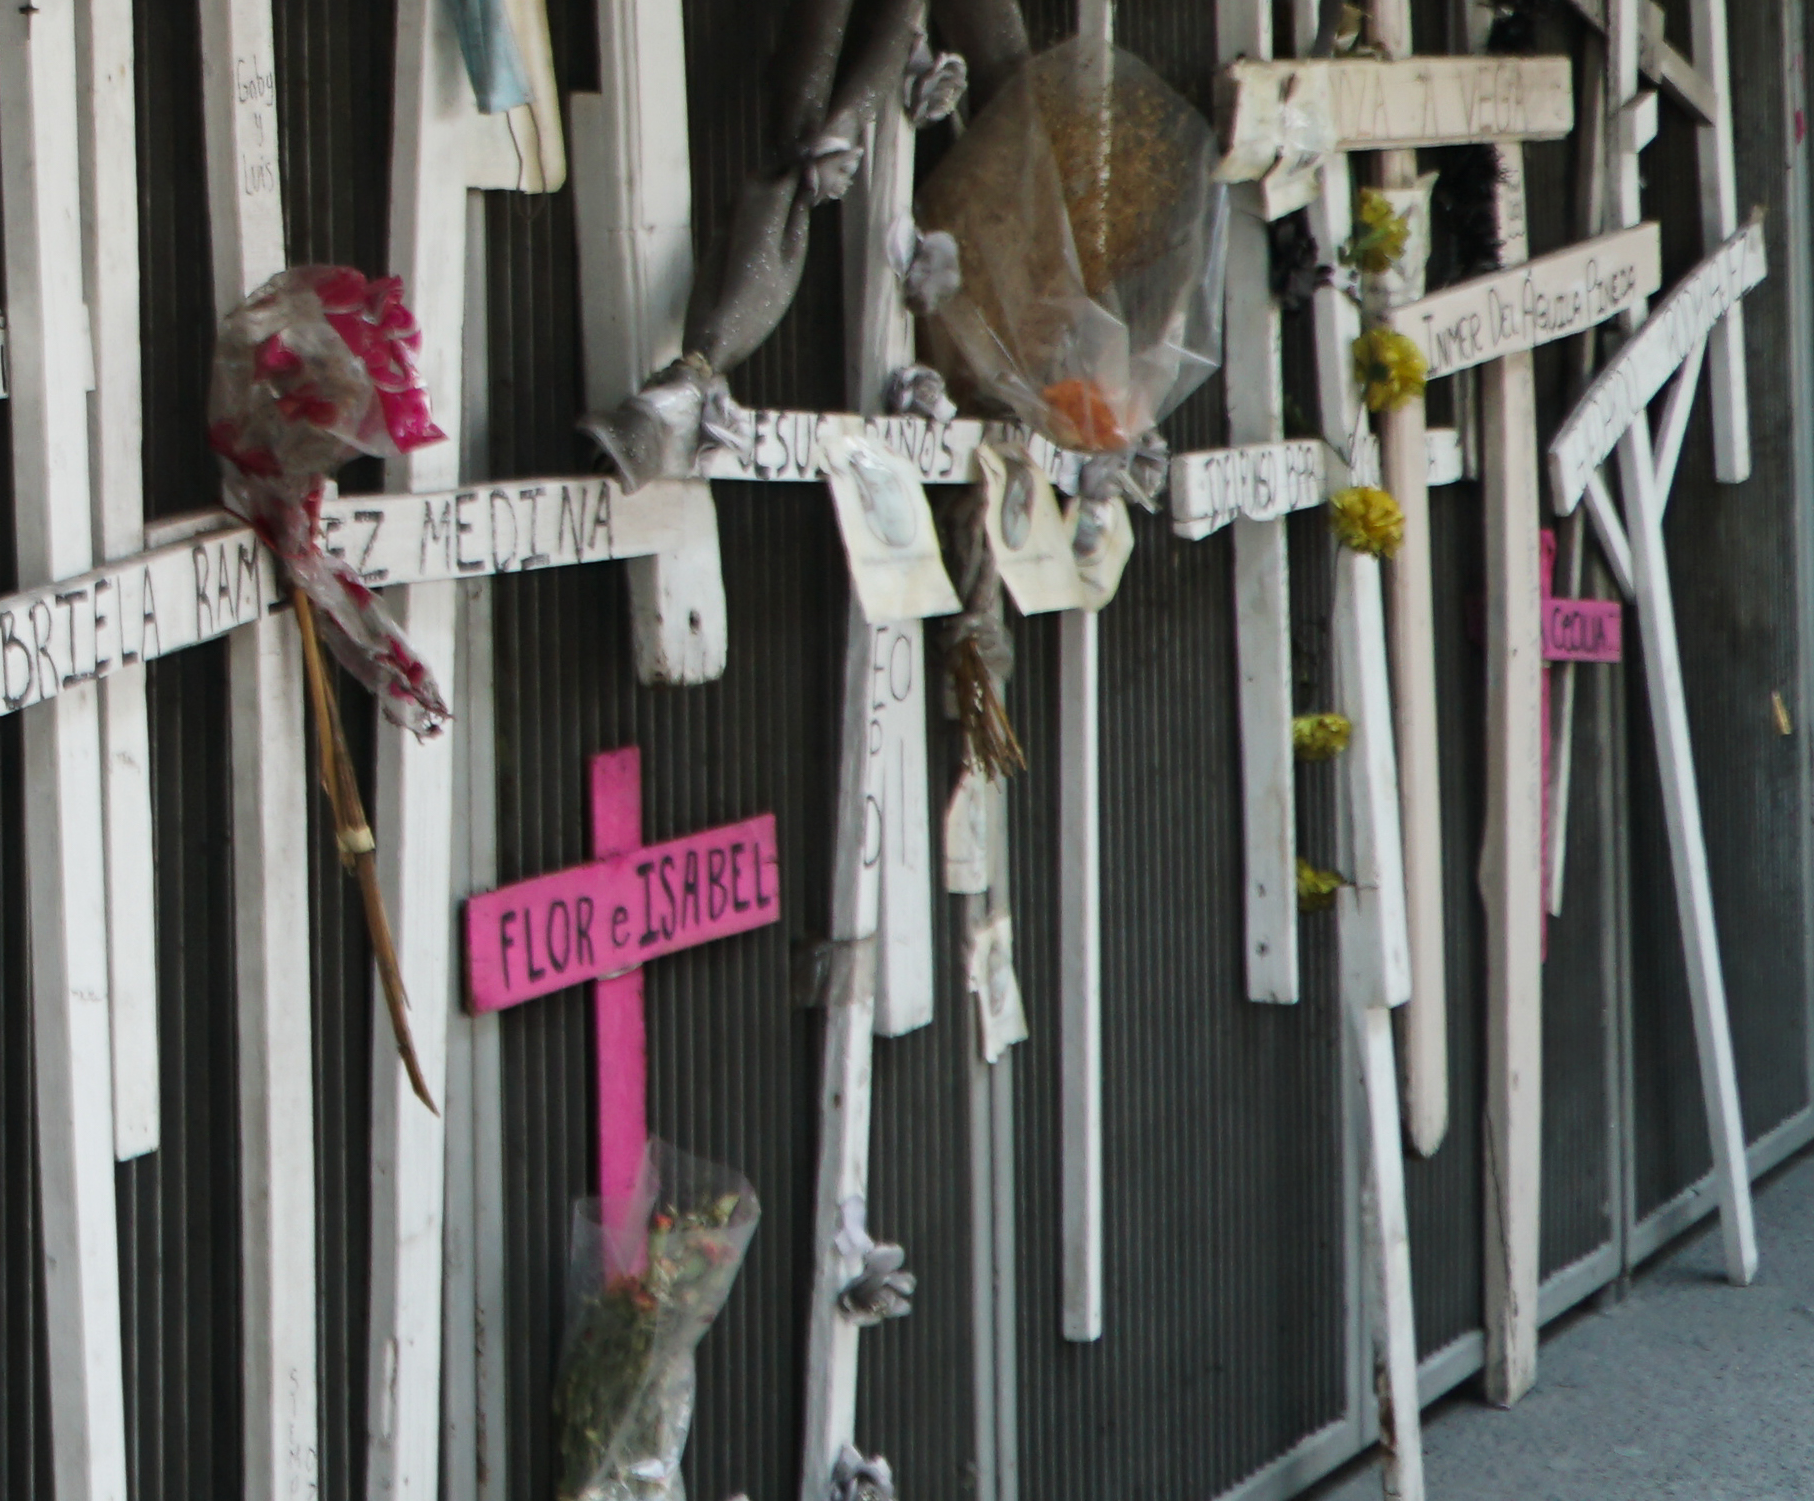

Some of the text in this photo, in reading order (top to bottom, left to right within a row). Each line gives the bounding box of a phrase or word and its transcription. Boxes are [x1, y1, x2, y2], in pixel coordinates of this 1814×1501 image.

[237, 53, 274, 107] Gaby
[191, 507, 390, 641] RAMEZ
[419, 483, 616, 585] MEDINA
[499, 842, 773, 991] FLOR e ISABEL
